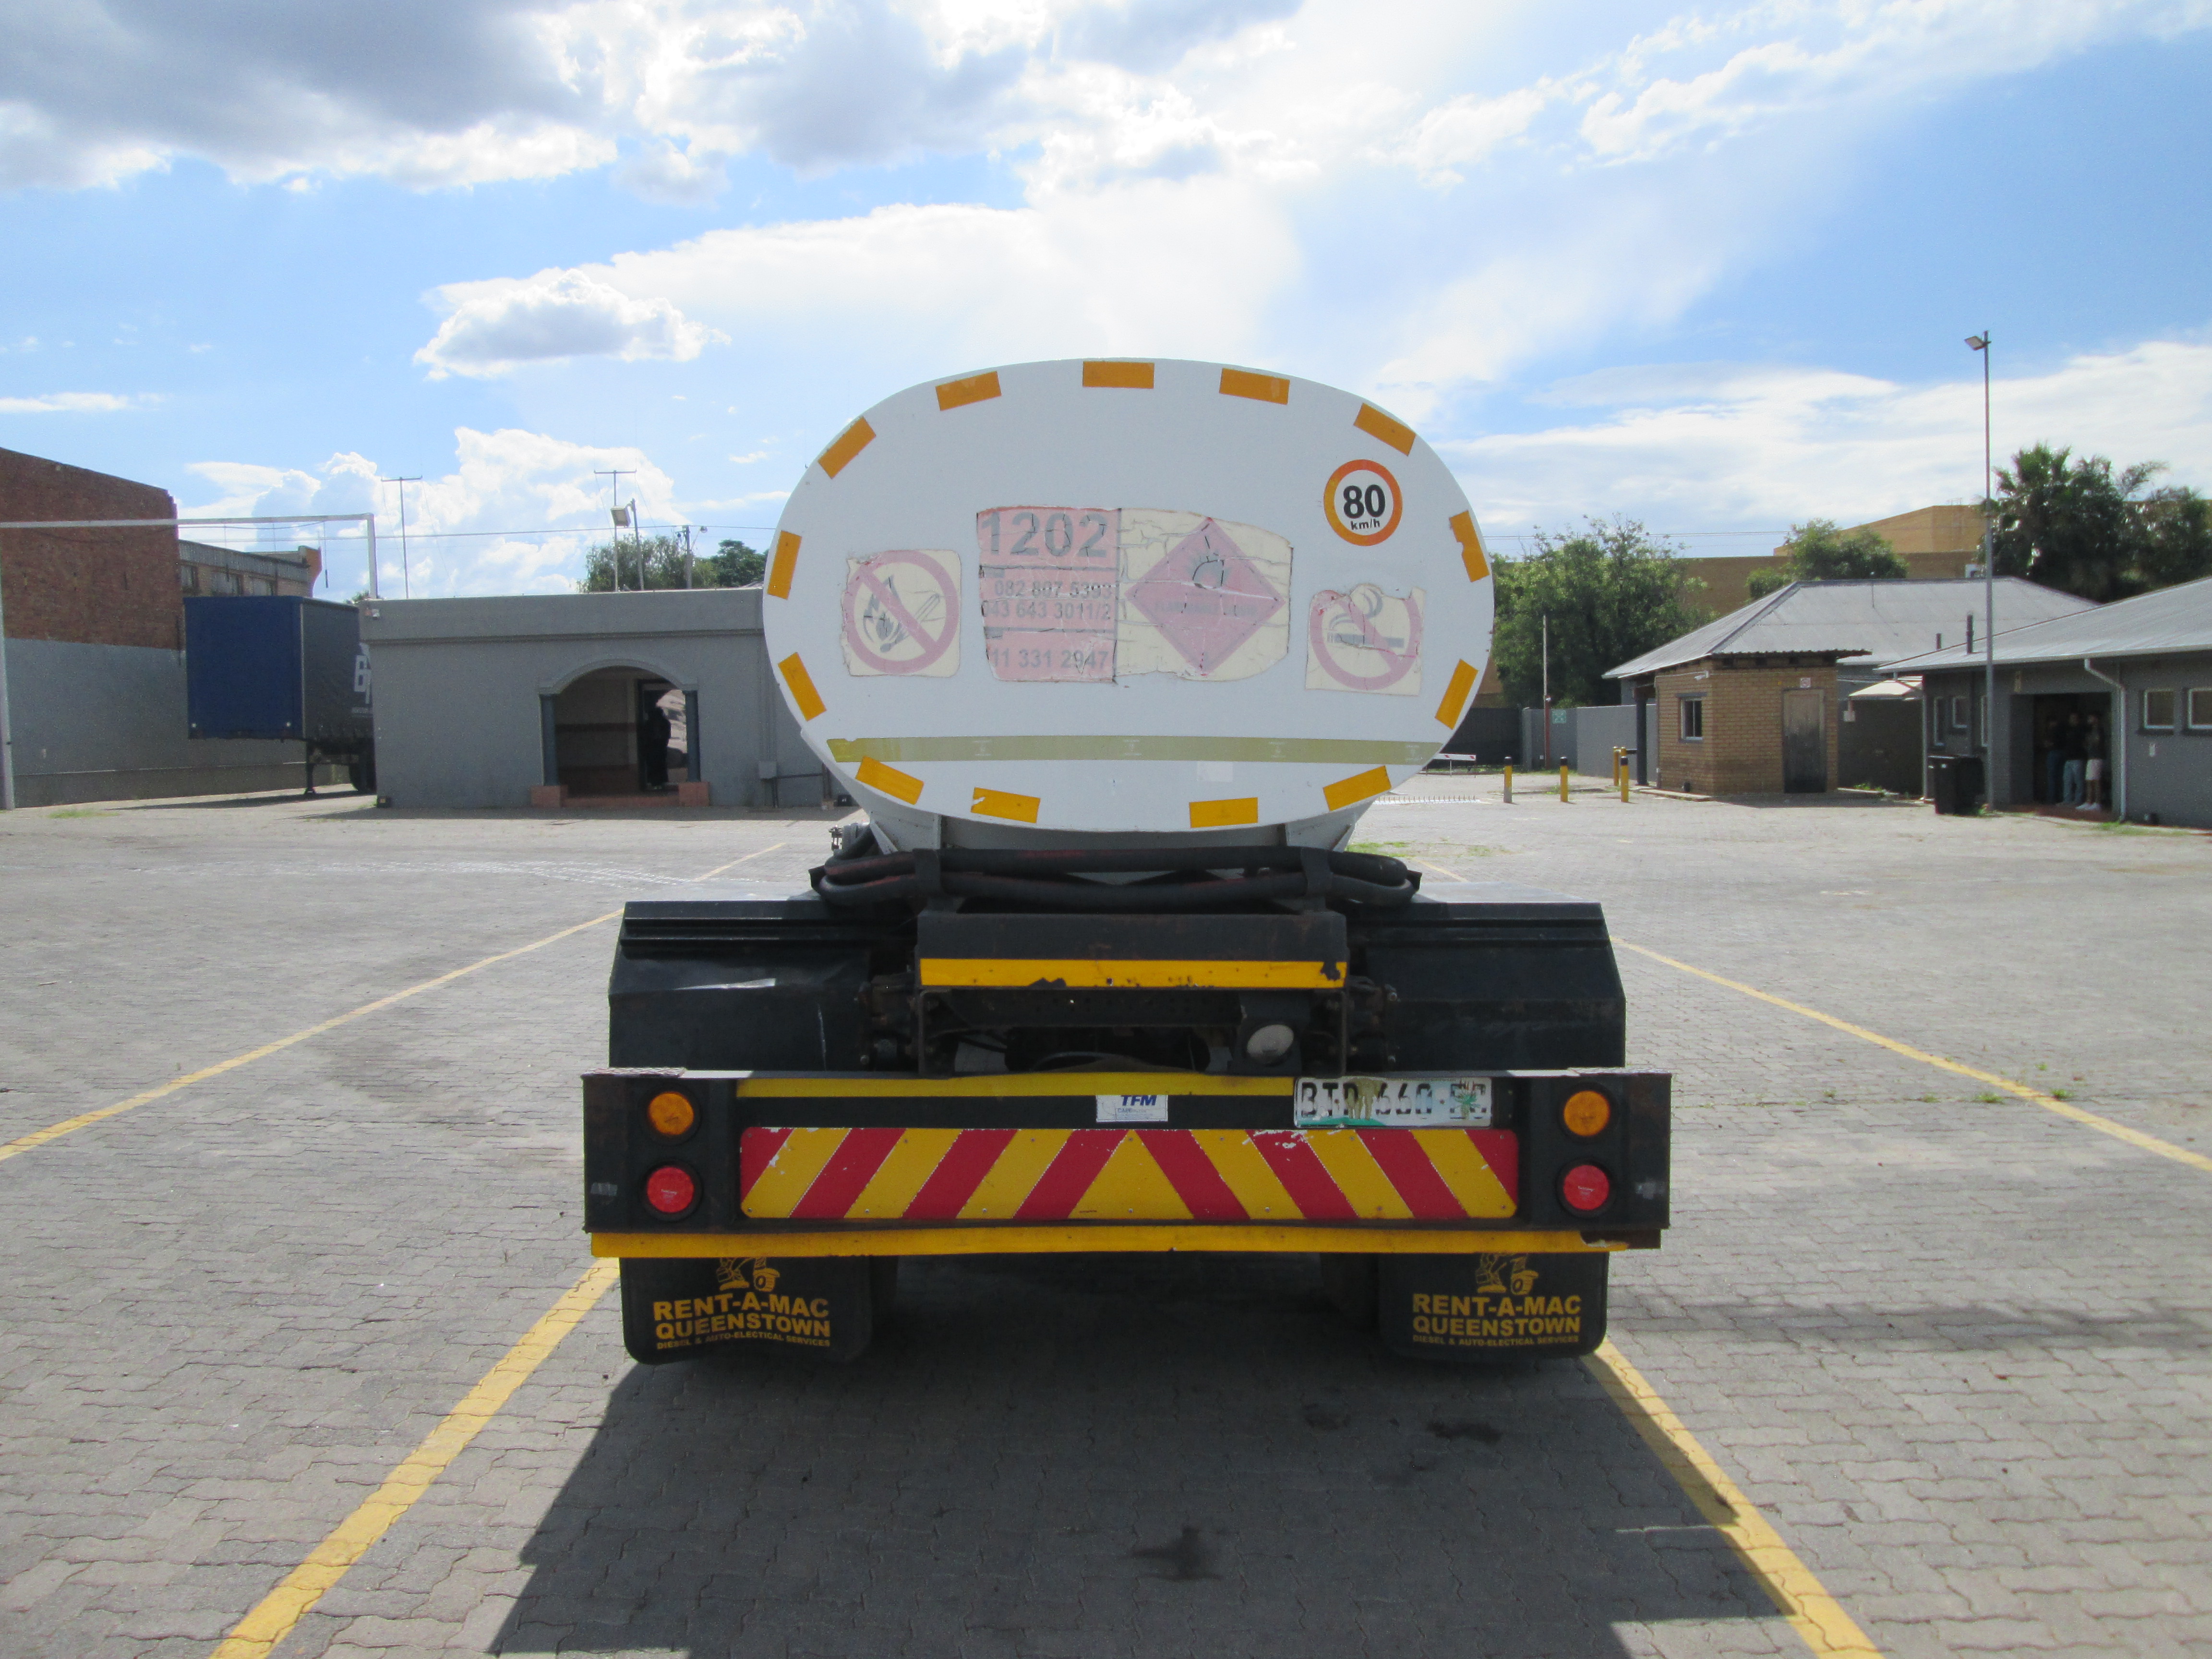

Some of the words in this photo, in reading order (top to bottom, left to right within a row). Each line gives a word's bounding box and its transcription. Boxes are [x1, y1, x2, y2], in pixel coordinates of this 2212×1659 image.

[1343, 484, 1385, 519] 80
[981, 511, 1107, 557] 1202
[1350, 518, 1381, 530] km/h
[995, 580, 1026, 597] 082
[1016, 601, 1047, 619] 643
[1019, 649, 1053, 668] 331
[1061, 649, 1109, 669] 2947
[1121, 1095, 1158, 1106] TFM
[653, 1292, 829, 1321] RENT-A-MAC
[1413, 1293, 1582, 1317] RENT-A-MAC
[656, 1313, 830, 1340] QUEENSTOWN
[1413, 1316, 1582, 1336] QUEENSTOWN
